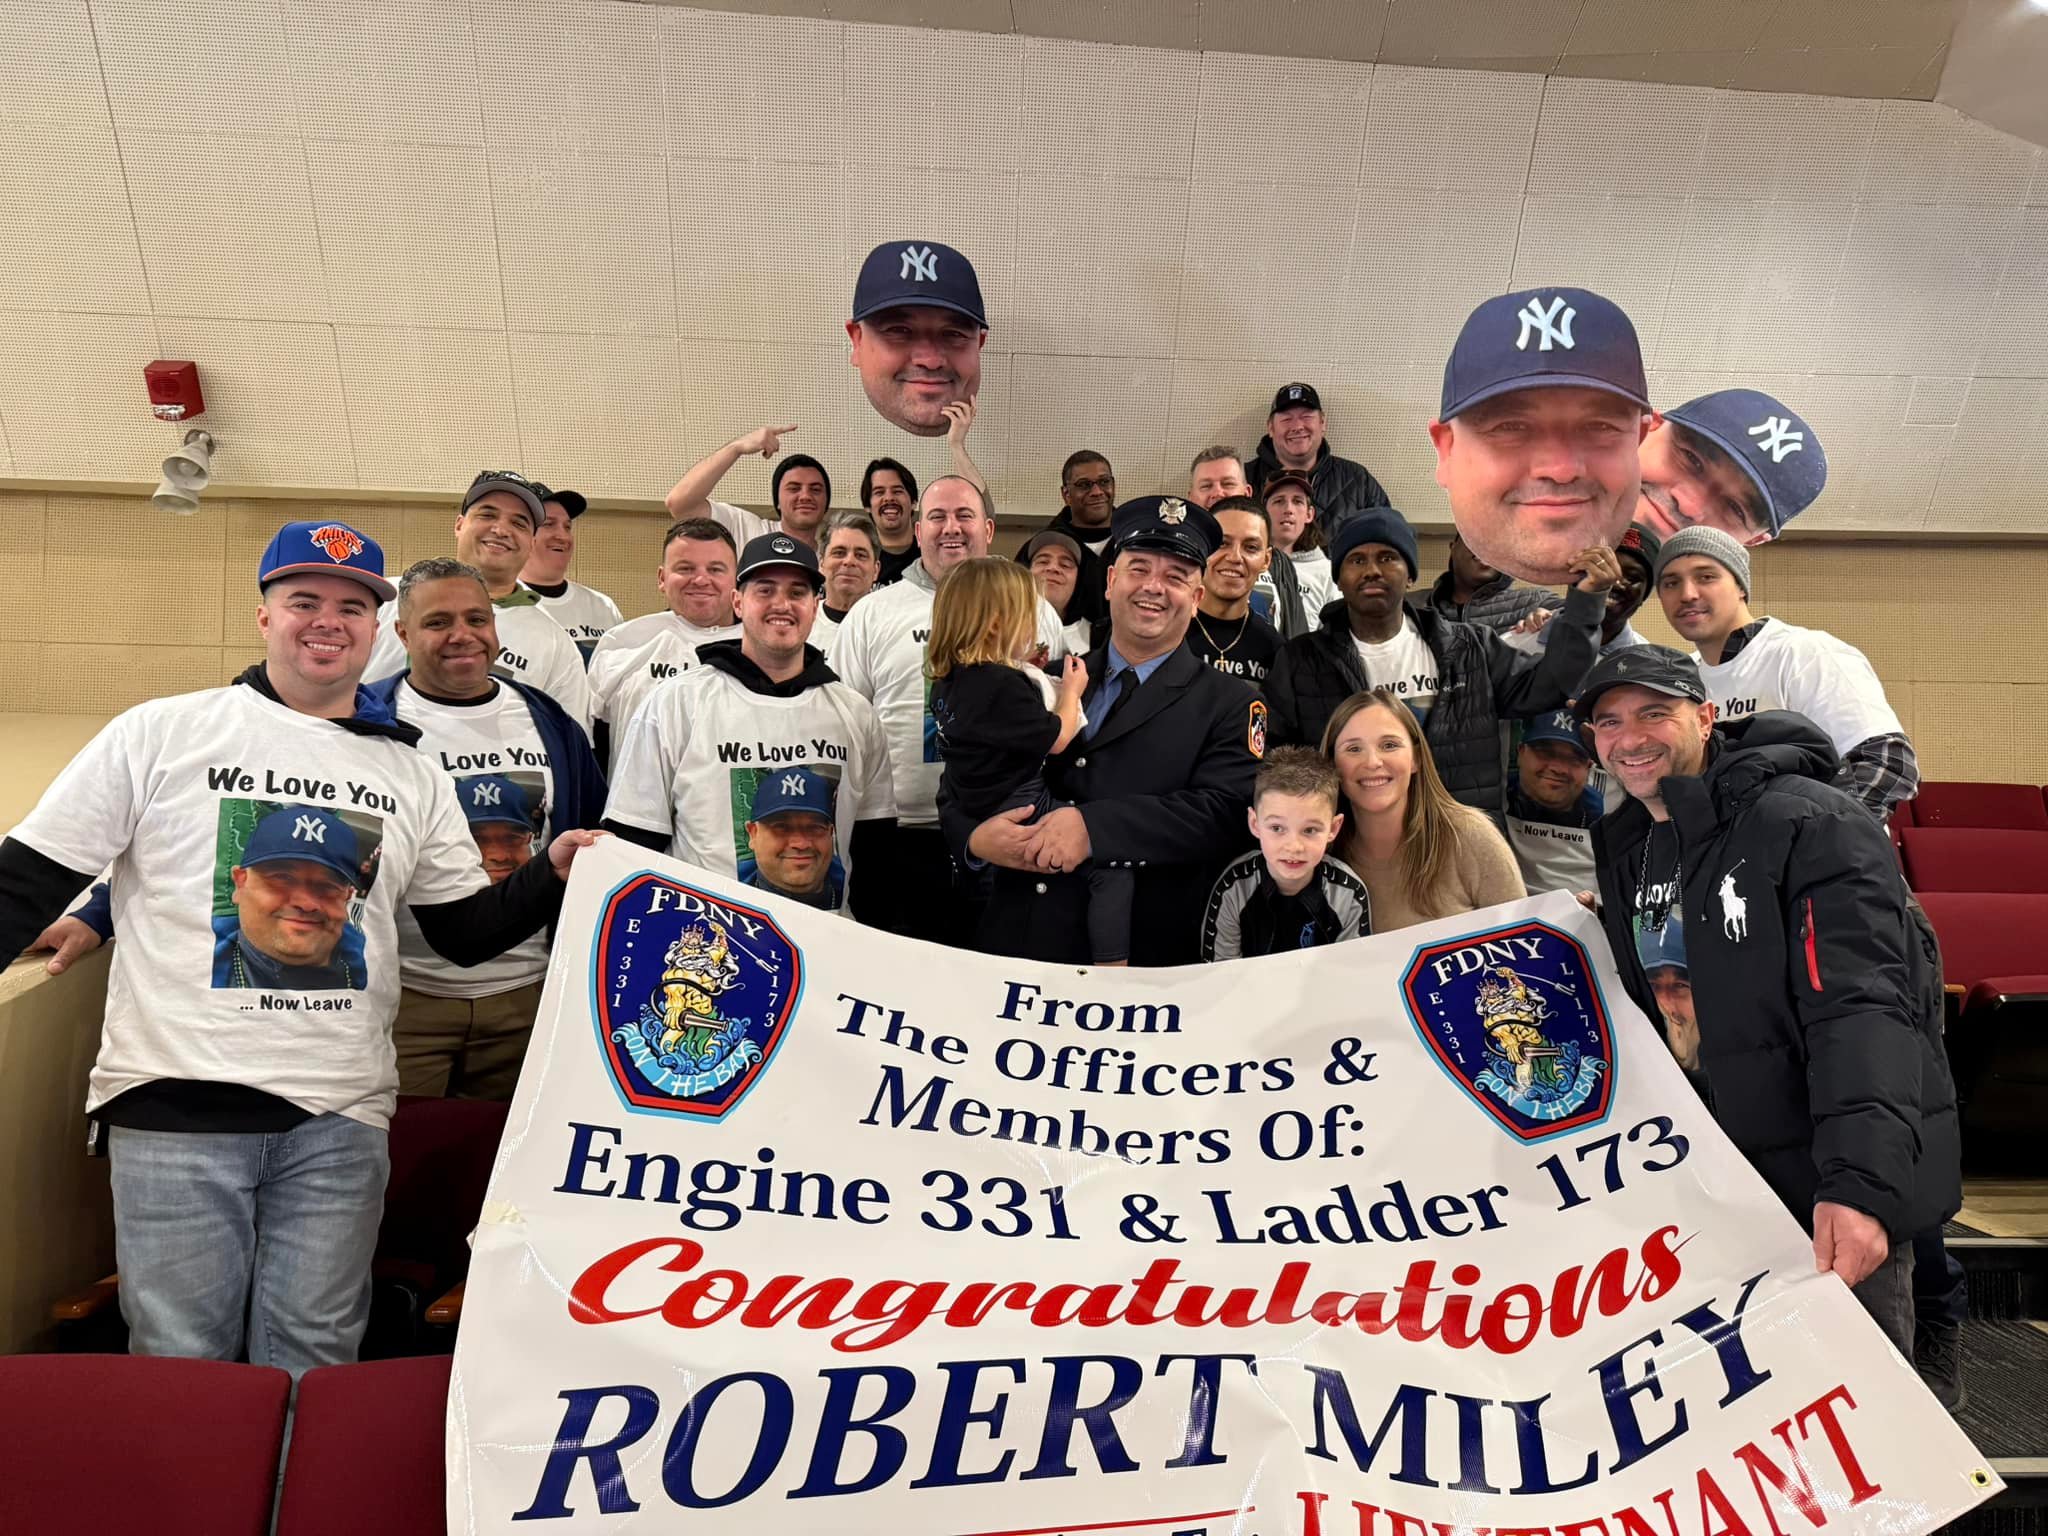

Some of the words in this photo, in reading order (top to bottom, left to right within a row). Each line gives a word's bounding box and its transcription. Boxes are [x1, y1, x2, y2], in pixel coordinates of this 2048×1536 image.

[900, 245, 938, 282] NY
[1516, 296, 1576, 351] NY
[1726, 697, 1757, 716] You
[440, 752, 501, 772] Love
[717, 742, 752, 763] We
[758, 742, 806, 762] Love
[811, 739, 847, 761] You
[207, 766, 254, 792] We
[265, 769, 336, 800] Love
[346, 781, 397, 815] You
[1525, 825, 1549, 837] Now
[1552, 828, 1584, 843] Leave
[646, 886, 764, 941] FDNY
[1431, 937, 1545, 986] FDNY
[260, 994, 300, 1011] Now
[304, 996, 352, 1011] Leave
[996, 980, 1182, 1033] From
[836, 992, 969, 1065] The
[994, 1038, 1295, 1096] Officers
[1323, 1036, 1379, 1086] &
[858, 1063, 1232, 1165] Members
[1258, 1104, 1365, 1161] Of:
[552, 1121, 891, 1232] Engine
[919, 1169, 1081, 1240] 331
[1119, 1192, 1188, 1243] &
[1202, 1180, 1509, 1245] Ladder
[1535, 1115, 1690, 1214] 173
[567, 1225, 1700, 1355] Congratulations
[511, 1353, 1258, 1522] ROBERT
[1302, 1270, 1773, 1496] MILEY
